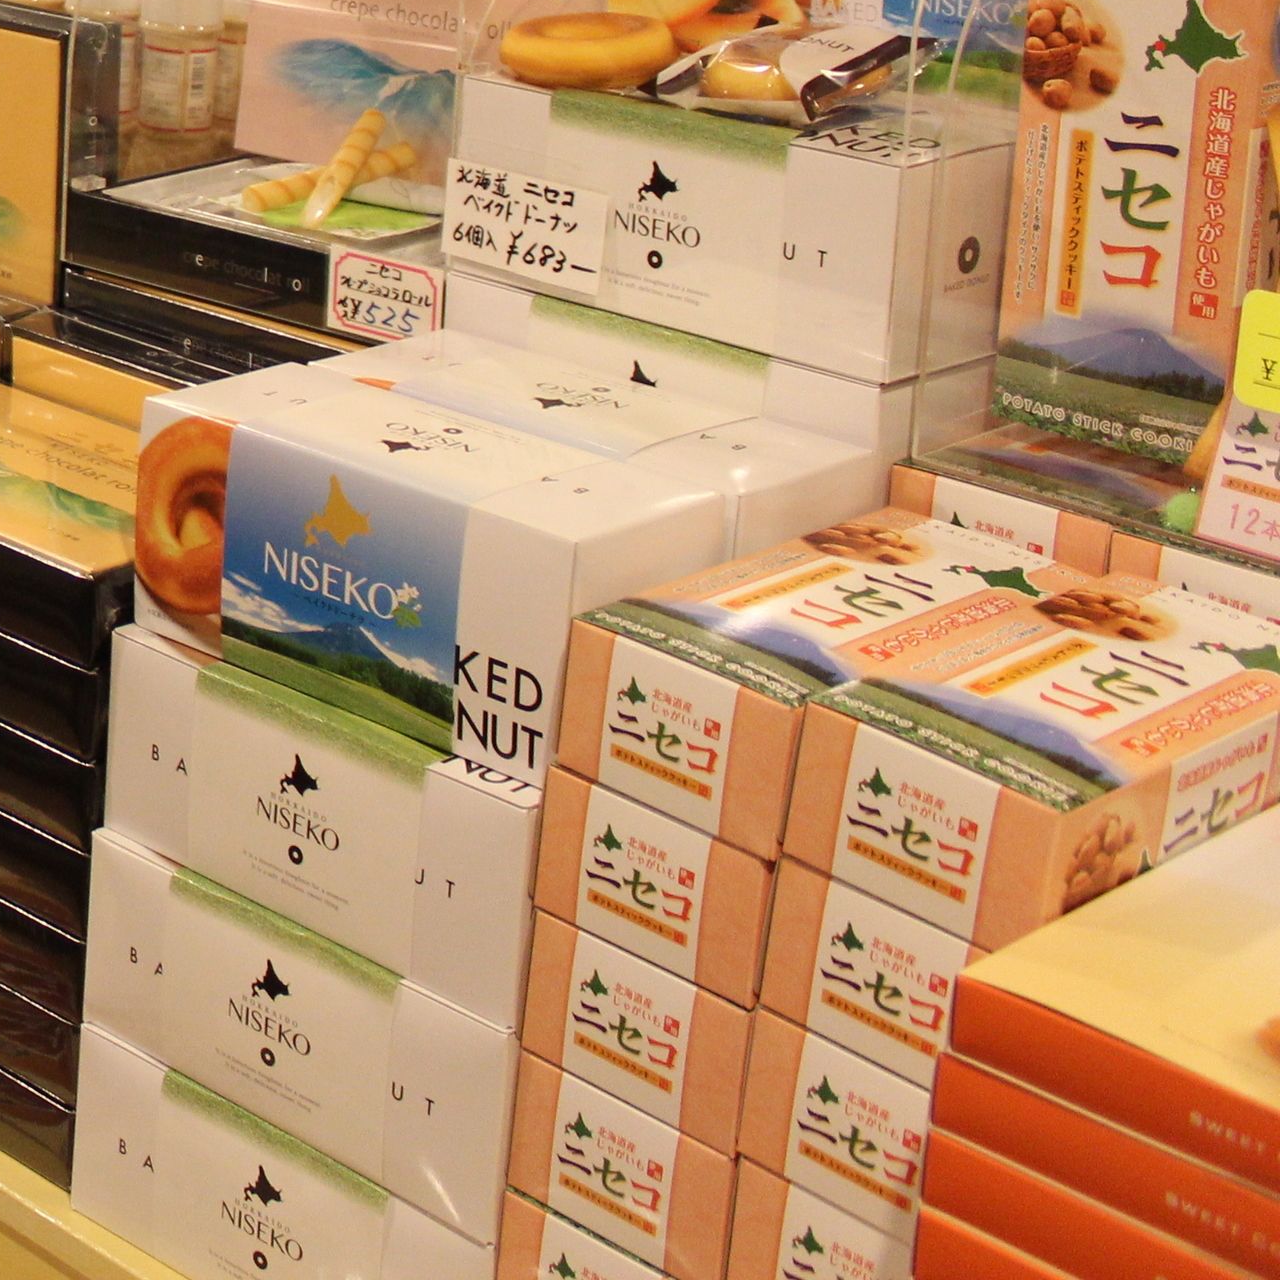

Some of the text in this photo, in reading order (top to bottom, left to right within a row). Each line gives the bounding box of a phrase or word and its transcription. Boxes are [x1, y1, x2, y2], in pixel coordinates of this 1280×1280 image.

[456, 163, 576, 208] 北海道 ニセコ
[1100, 111, 1181, 288] ニセコ
[1194, 87, 1237, 290] 北海道産じゃがいも
[452, 221, 499, 253] 6個入
[613, 207, 702, 249] NISEKO
[365, 263, 402, 282] ニセコ
[1002, 391, 1196, 454] POTATO STICK COOKI
[263, 541, 400, 621] NISEKO
[456, 705, 543, 771] NUT
[608, 709, 719, 775] ニセコ
[256, 796, 341, 851] NISEKO
[845, 799, 975, 876] ニセコ
[585, 855, 695, 923] ニセコ
[227, 997, 312, 1056] NISEKO
[819, 954, 946, 1033] ニセコ
[572, 999, 679, 1071] ニセコ
[556, 1141, 663, 1215] ニセコ
[797, 1106, 920, 1189] ニセコ
[220, 1199, 304, 1261] NISEKO
